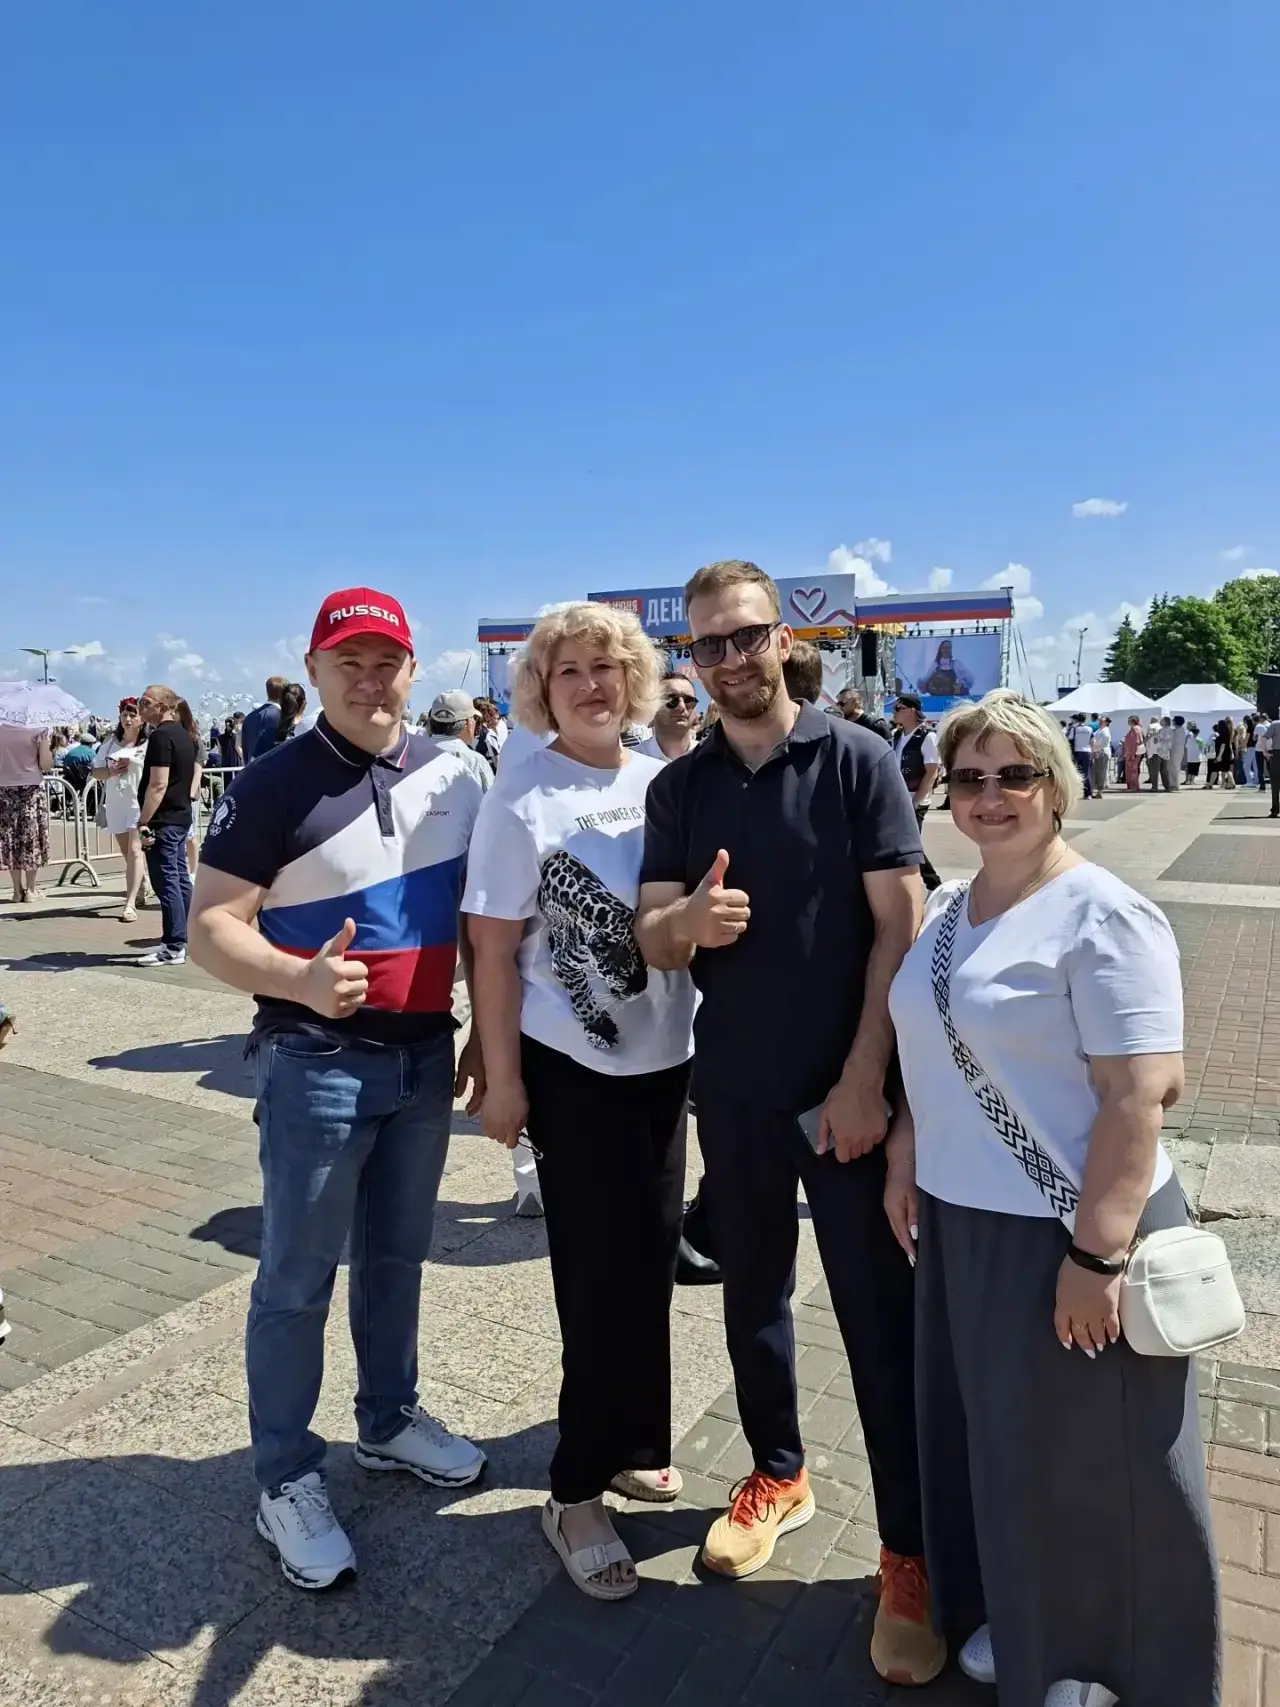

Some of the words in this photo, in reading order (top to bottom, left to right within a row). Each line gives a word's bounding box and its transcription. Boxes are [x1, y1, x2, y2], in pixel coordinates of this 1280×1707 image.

[329, 604, 400, 627] RUSSIA
[646, 597, 687, 627] ДЕН
[574, 813, 599, 831] THE
[597, 807, 631, 825] POWER
[629, 806, 642, 820] IS
